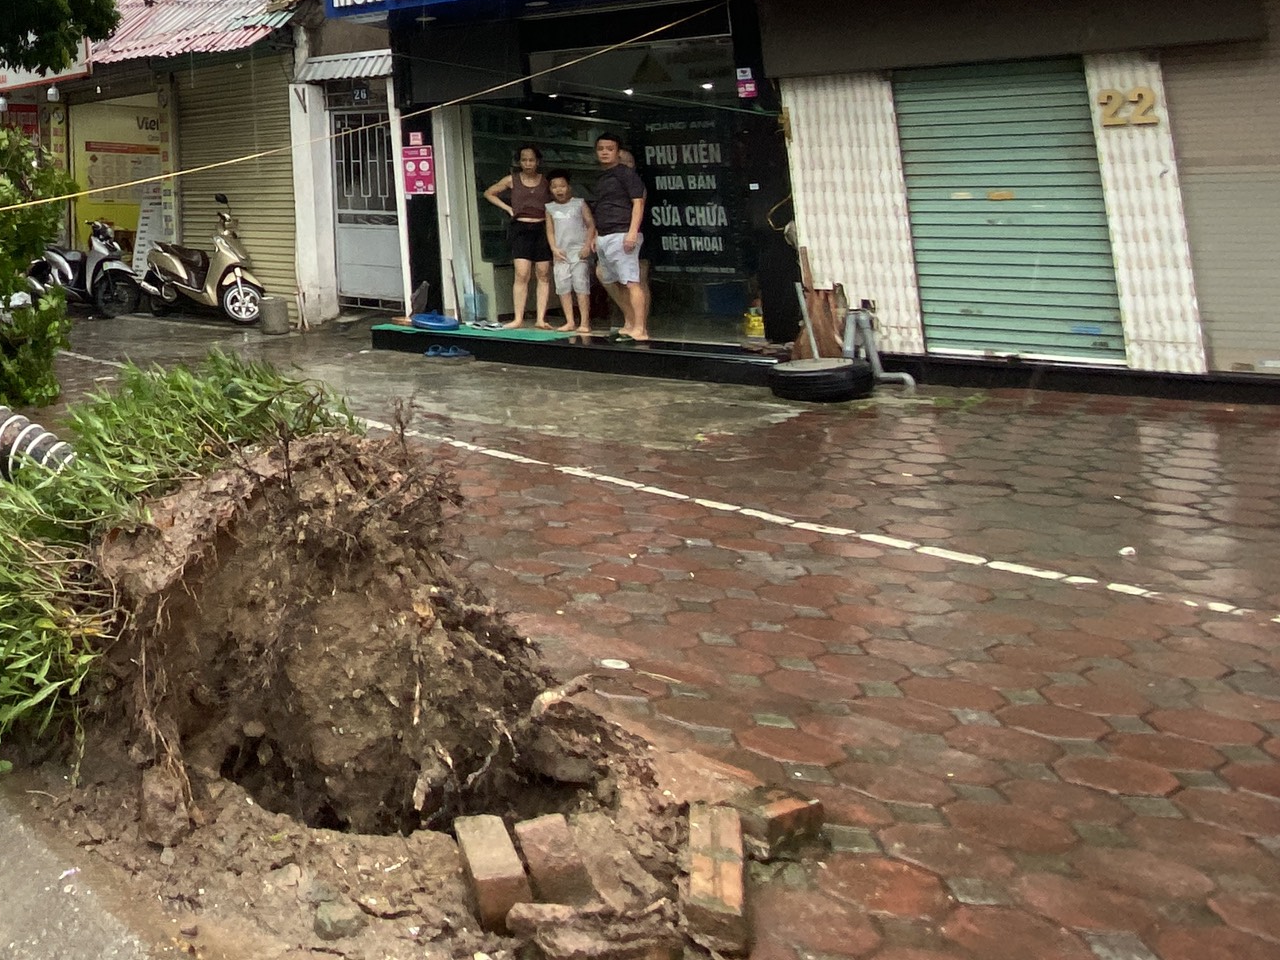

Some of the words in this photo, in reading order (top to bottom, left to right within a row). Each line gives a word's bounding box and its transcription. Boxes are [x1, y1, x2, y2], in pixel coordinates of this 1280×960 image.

[1098, 87, 1159, 127] 22
[645, 145, 678, 169] PHỤ
[681, 140, 722, 168] KIỆN
[655, 175, 685, 190] MUA
[651, 199, 682, 226] SỬA
[685, 202, 728, 227] CHỮA
